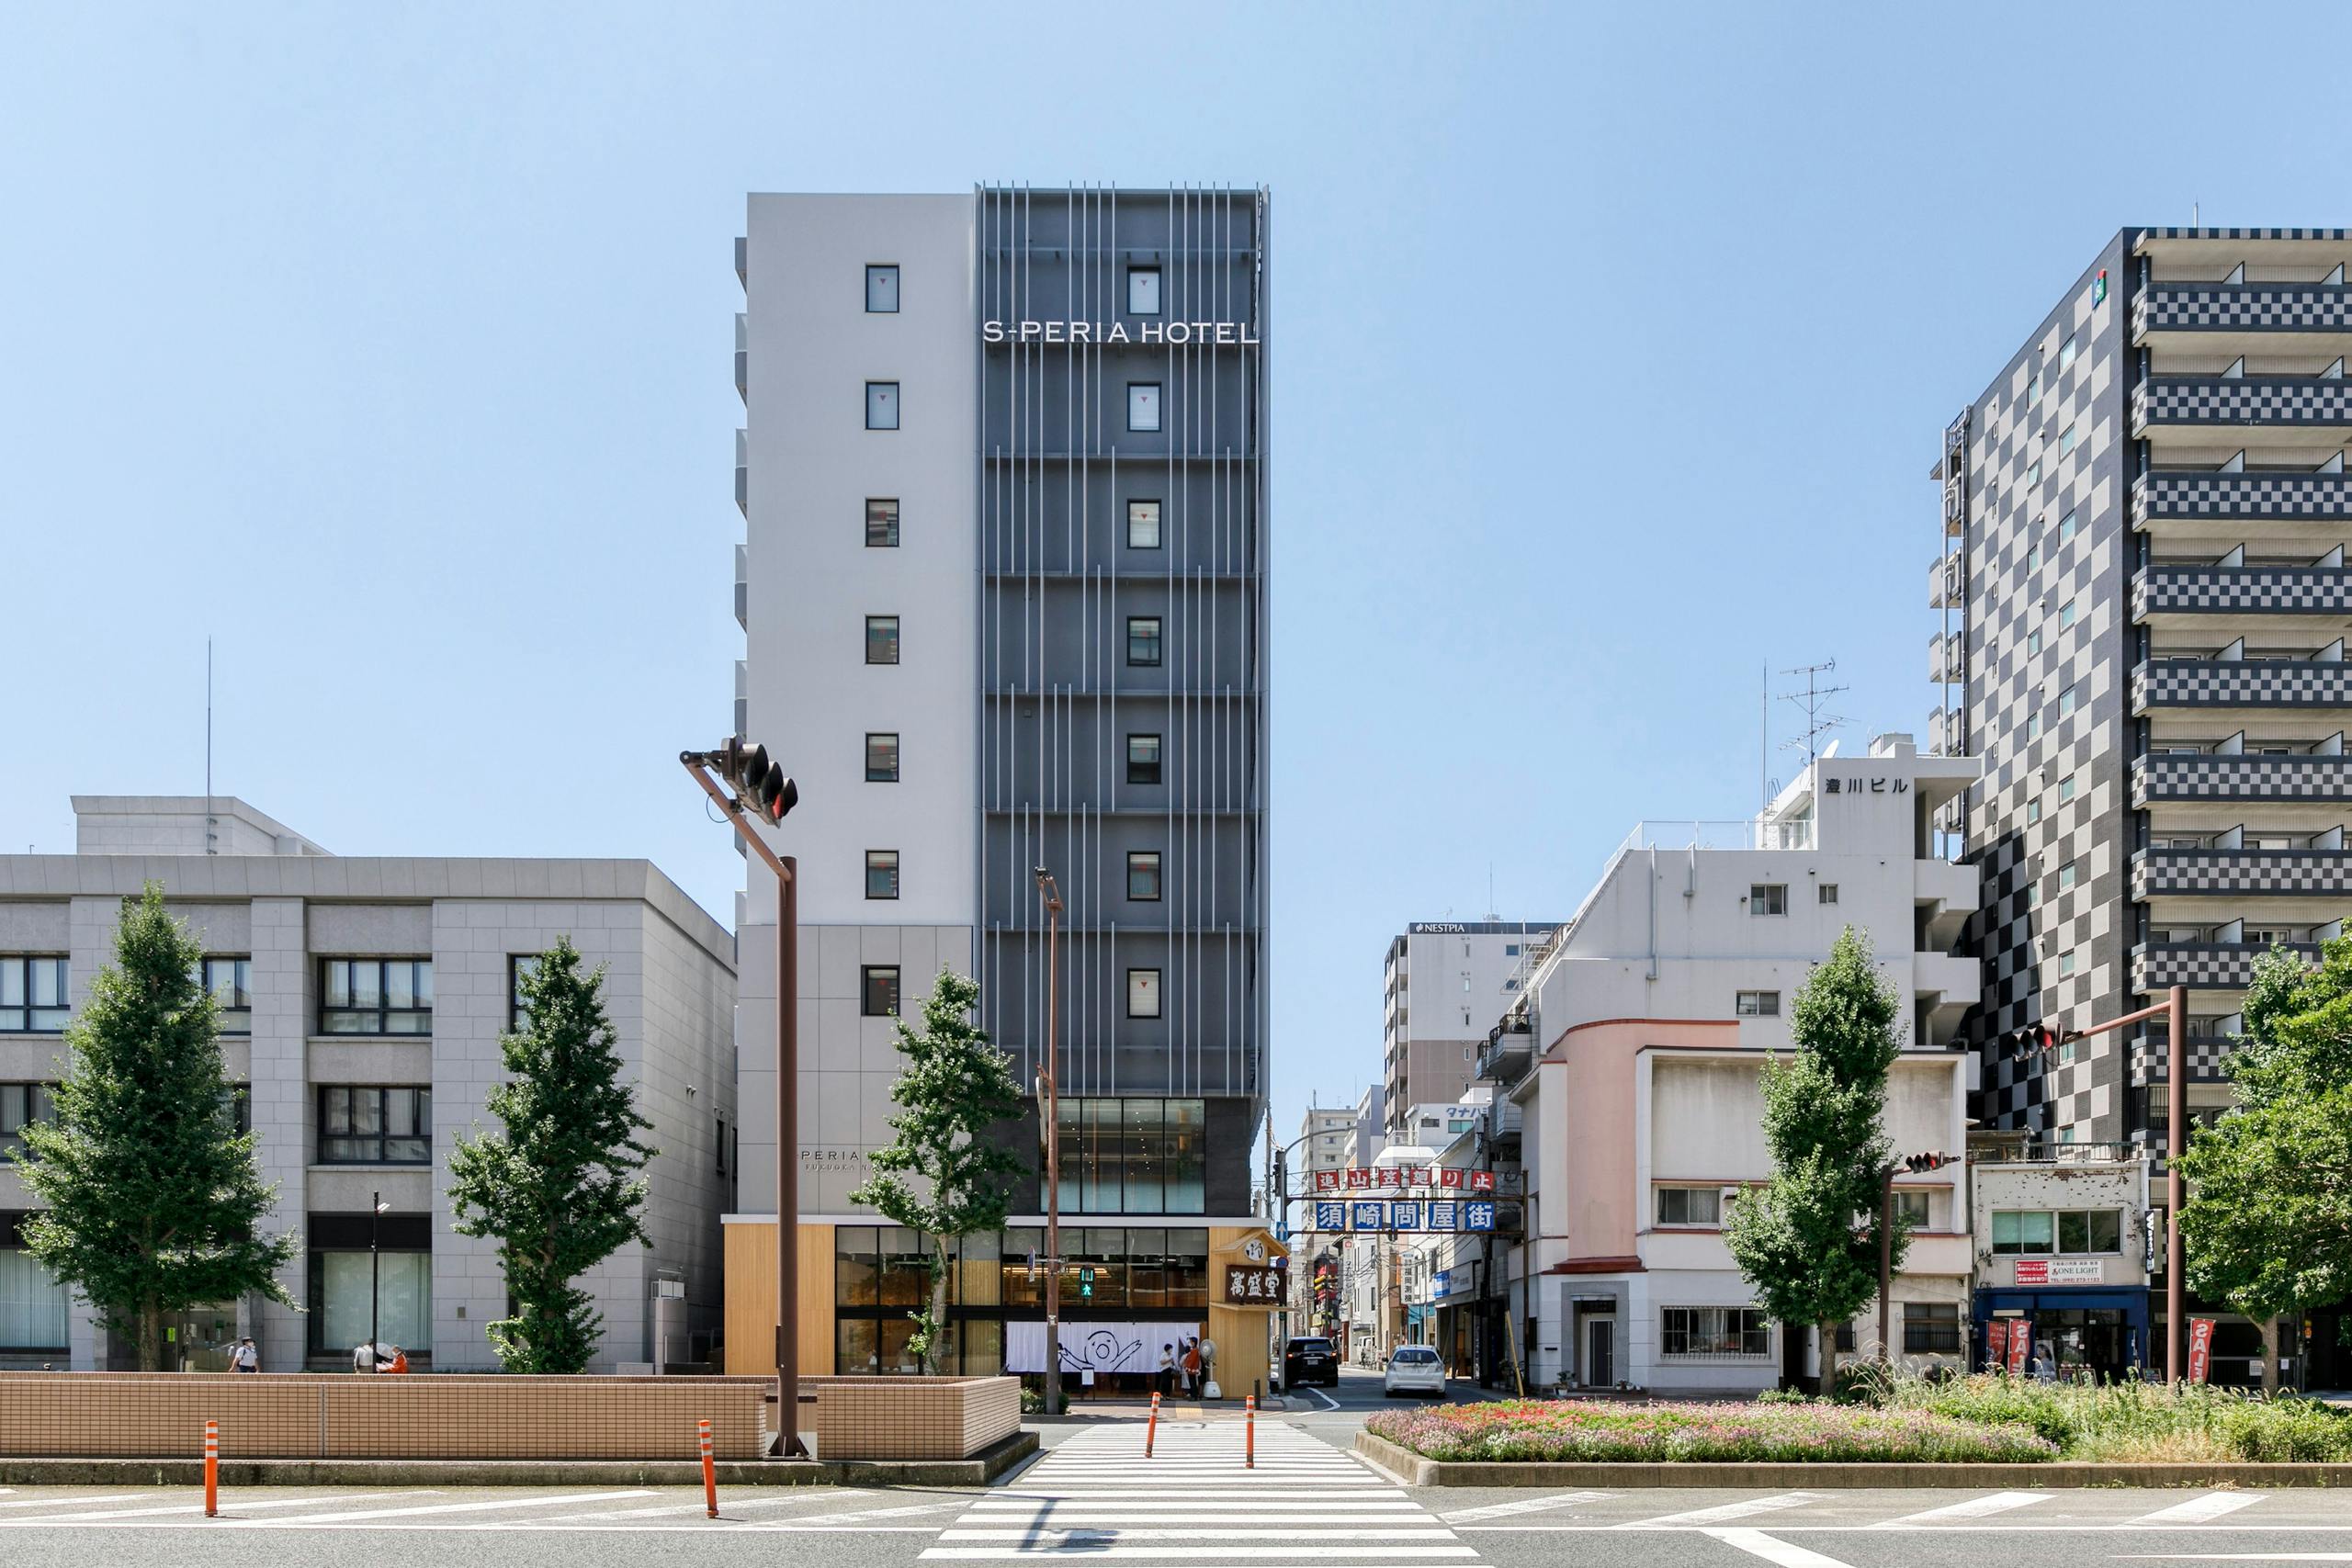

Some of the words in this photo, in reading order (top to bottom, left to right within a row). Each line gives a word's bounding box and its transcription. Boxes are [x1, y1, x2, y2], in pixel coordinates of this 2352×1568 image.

[982, 321, 1130, 344] S-PERIA
[1141, 321, 1260, 344] HOTEL
[1424, 923, 1464, 933] NESTPIA
[801, 1151, 859, 1160] PERIA
[1318, 1204, 1493, 1228] 須崎問屋街
